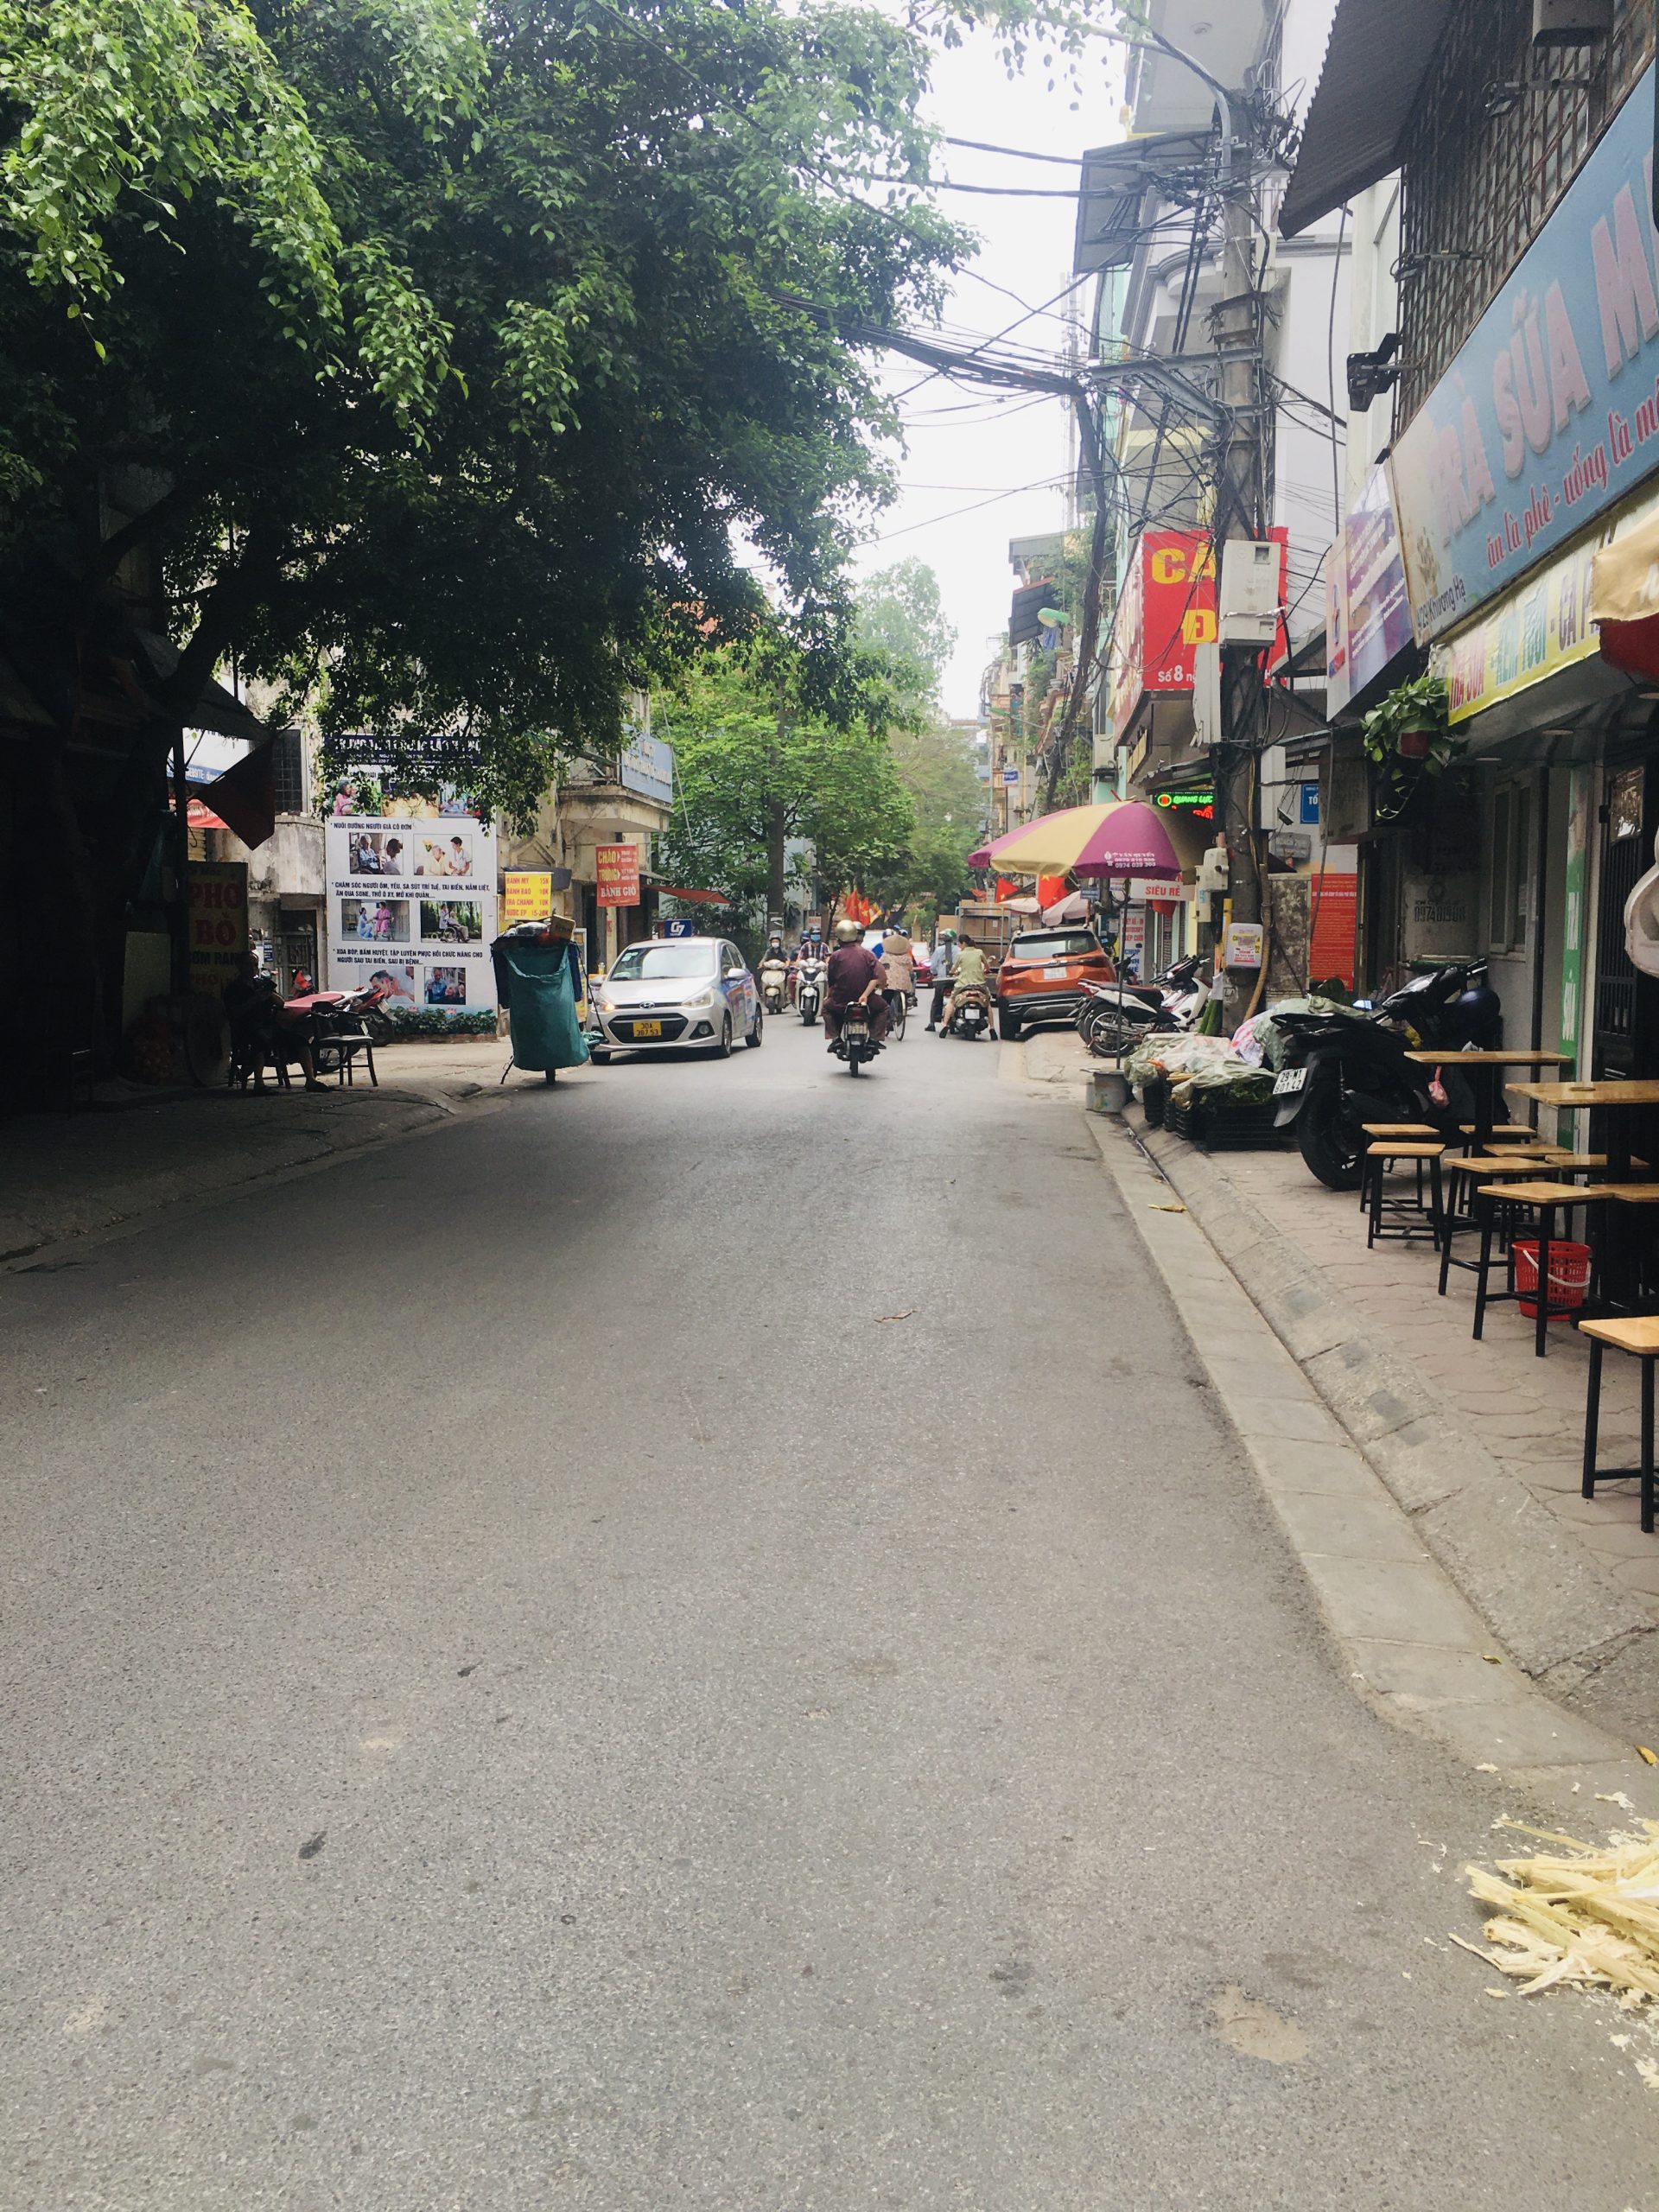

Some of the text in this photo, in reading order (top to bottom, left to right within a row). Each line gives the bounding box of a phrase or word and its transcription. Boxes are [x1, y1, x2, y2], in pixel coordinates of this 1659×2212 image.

[1494, 278, 1592, 478] SỮA
[1592, 154, 1659, 382] M
[1503, 512, 1522, 553] là
[1563, 444, 1610, 491] uống
[1607, 411, 1634, 466] là
[1636, 377, 1659, 443] m
[1453, 575, 1465, 602] Hạ
[1158, 668, 1173, 682] Số
[1173, 664, 1184, 682] 8
[601, 884, 621, 898] BÁNH
[1145, 885, 1166, 896] SIÊU
